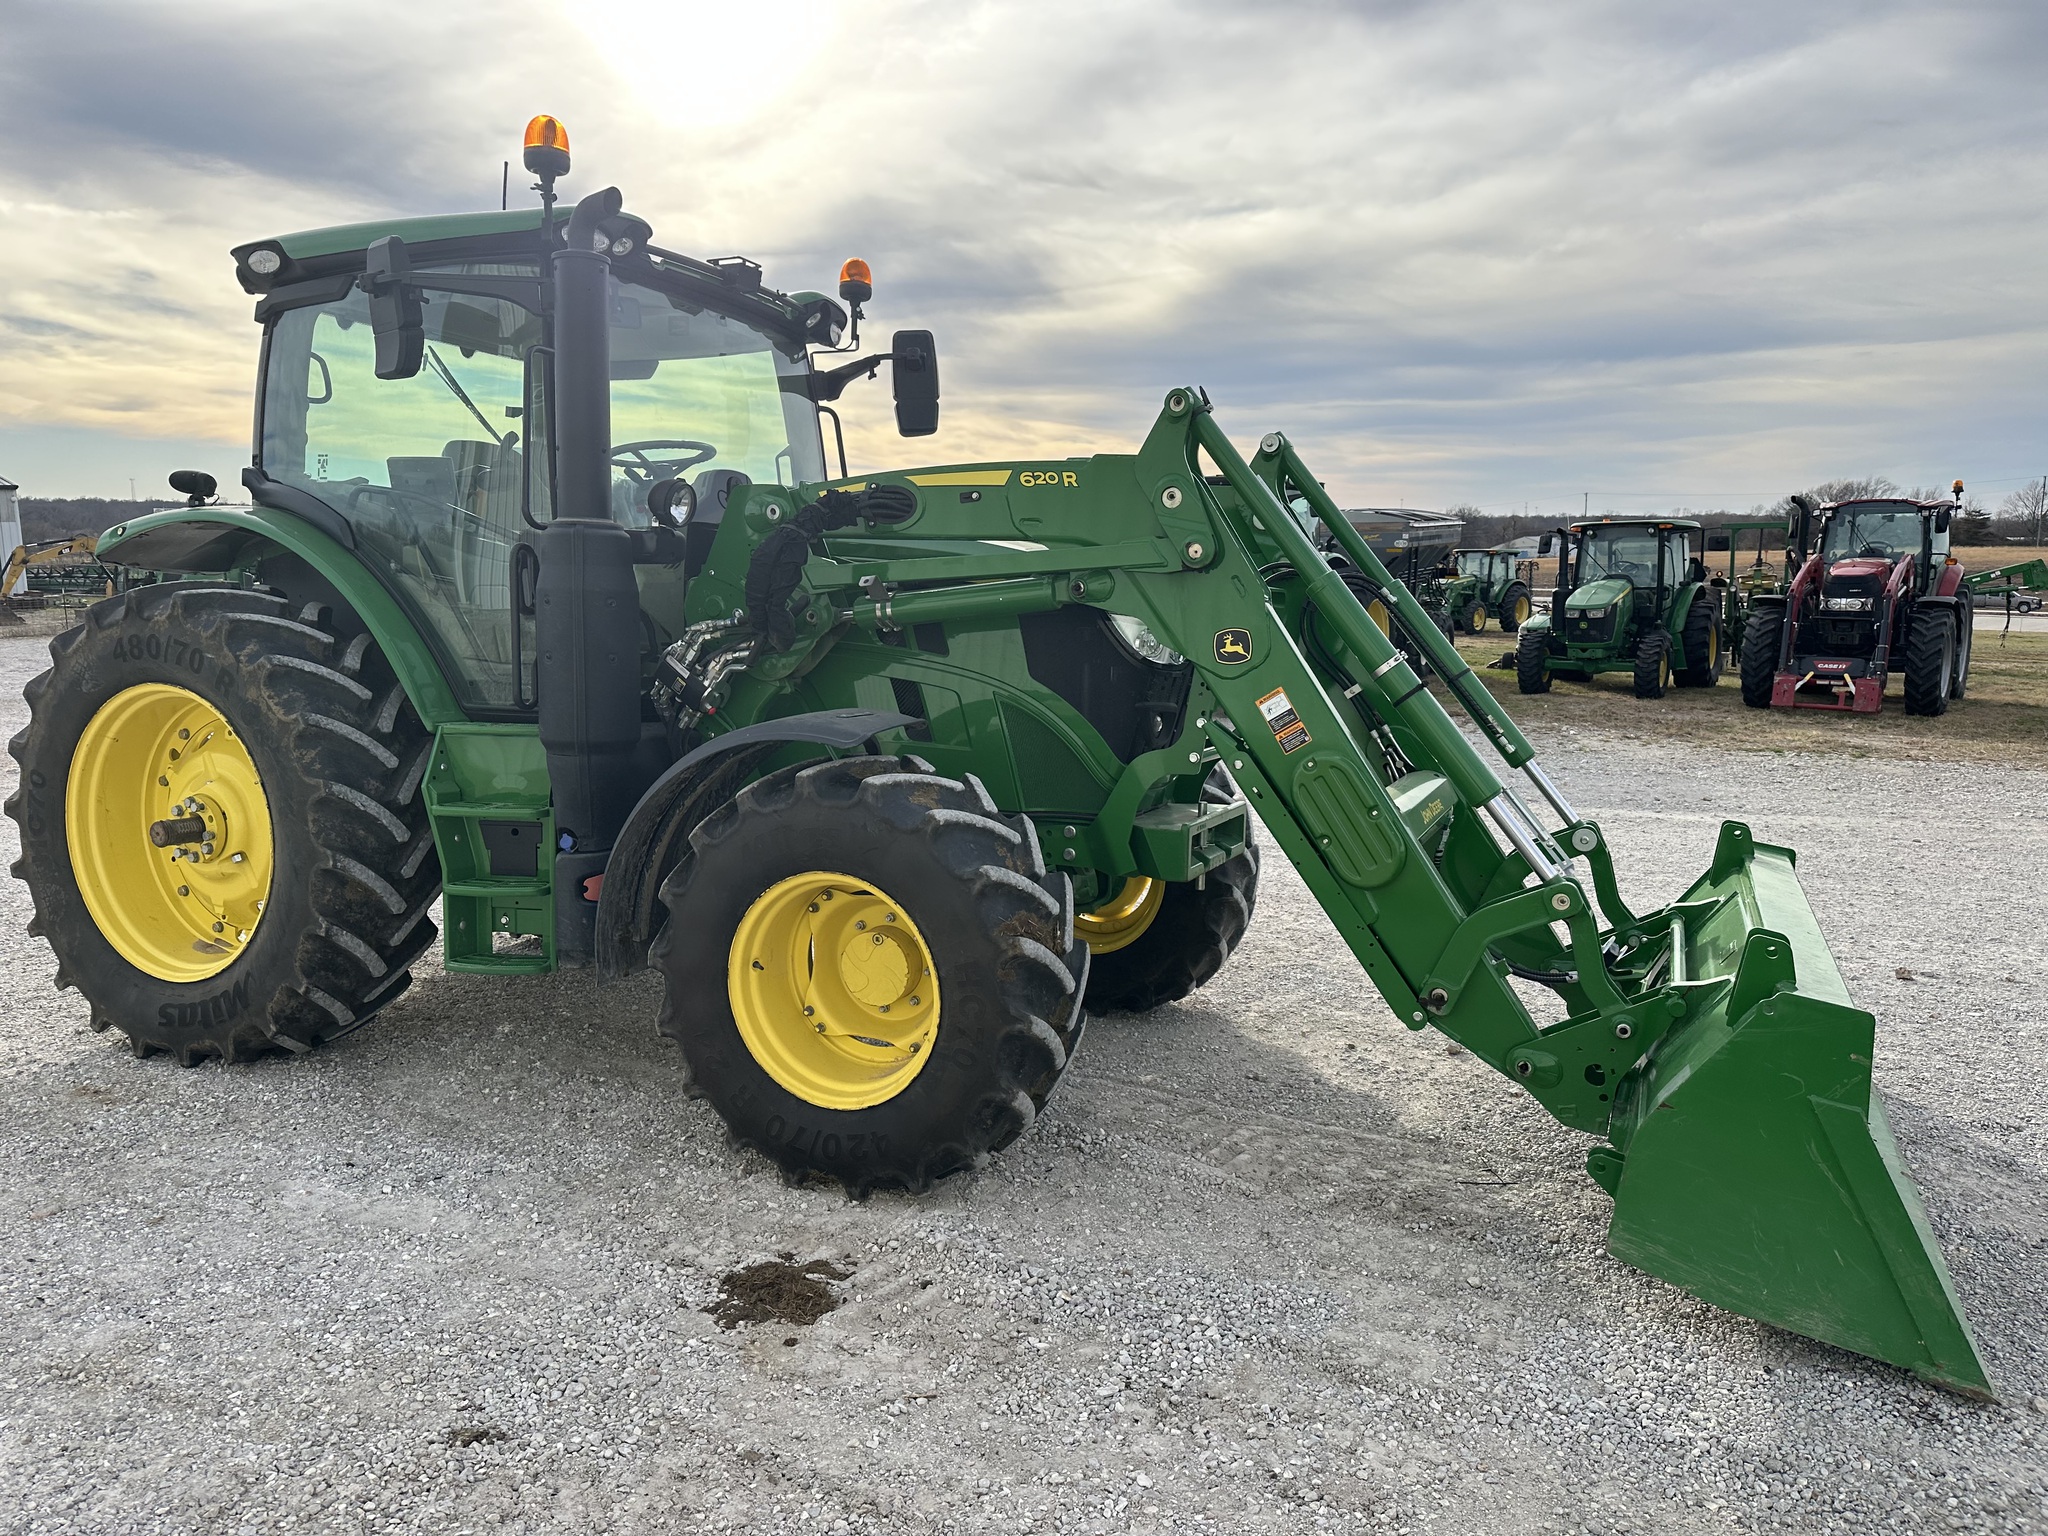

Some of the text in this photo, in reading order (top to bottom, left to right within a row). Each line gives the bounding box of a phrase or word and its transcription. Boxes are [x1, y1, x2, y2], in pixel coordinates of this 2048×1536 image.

[1019, 471, 1079, 487] 620 R
[113, 633, 204, 675] 480/70
[766, 1114, 888, 1161] 420/70
